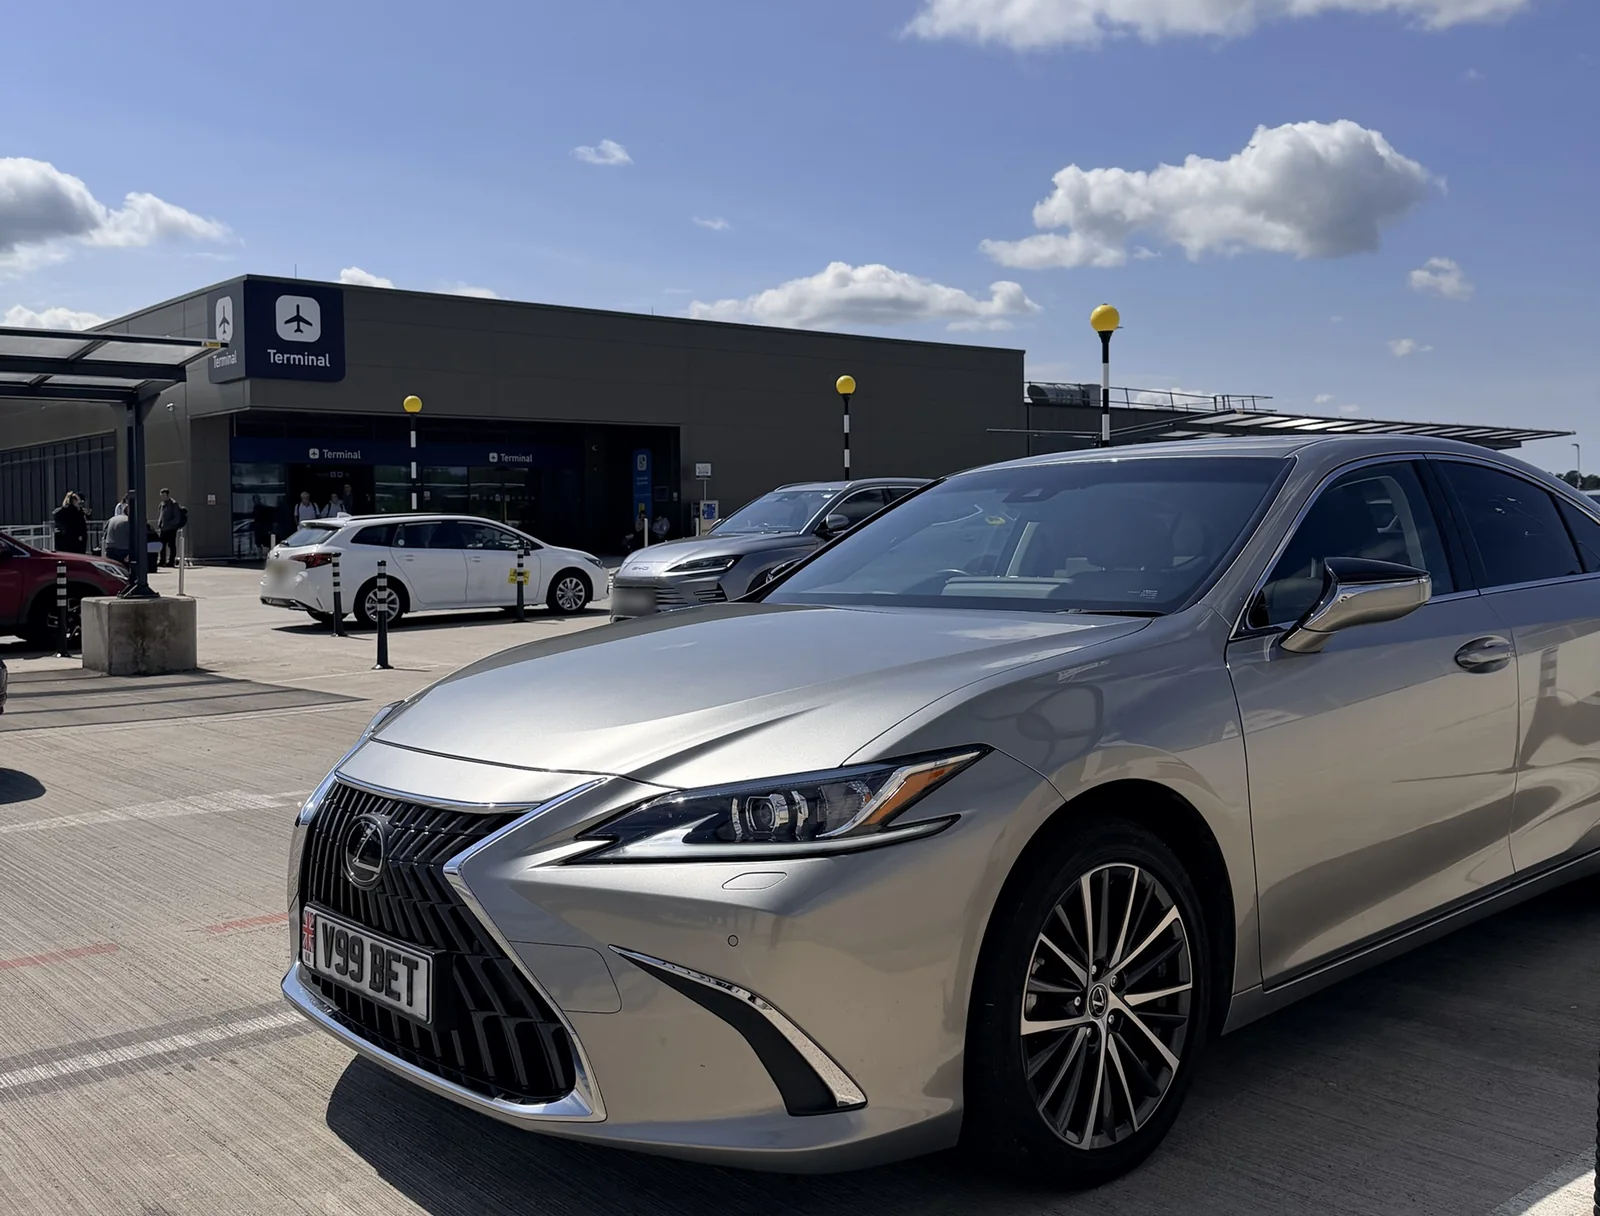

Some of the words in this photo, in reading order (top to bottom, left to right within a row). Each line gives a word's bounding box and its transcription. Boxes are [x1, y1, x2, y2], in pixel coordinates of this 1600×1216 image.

[213, 350, 237, 369] Terminal
[267, 349, 331, 367] Terminal
[322, 449, 362, 460] Terminal
[500, 453, 533, 463] Terminal
[321, 922, 364, 984] V99
[368, 942, 419, 1008] BET
